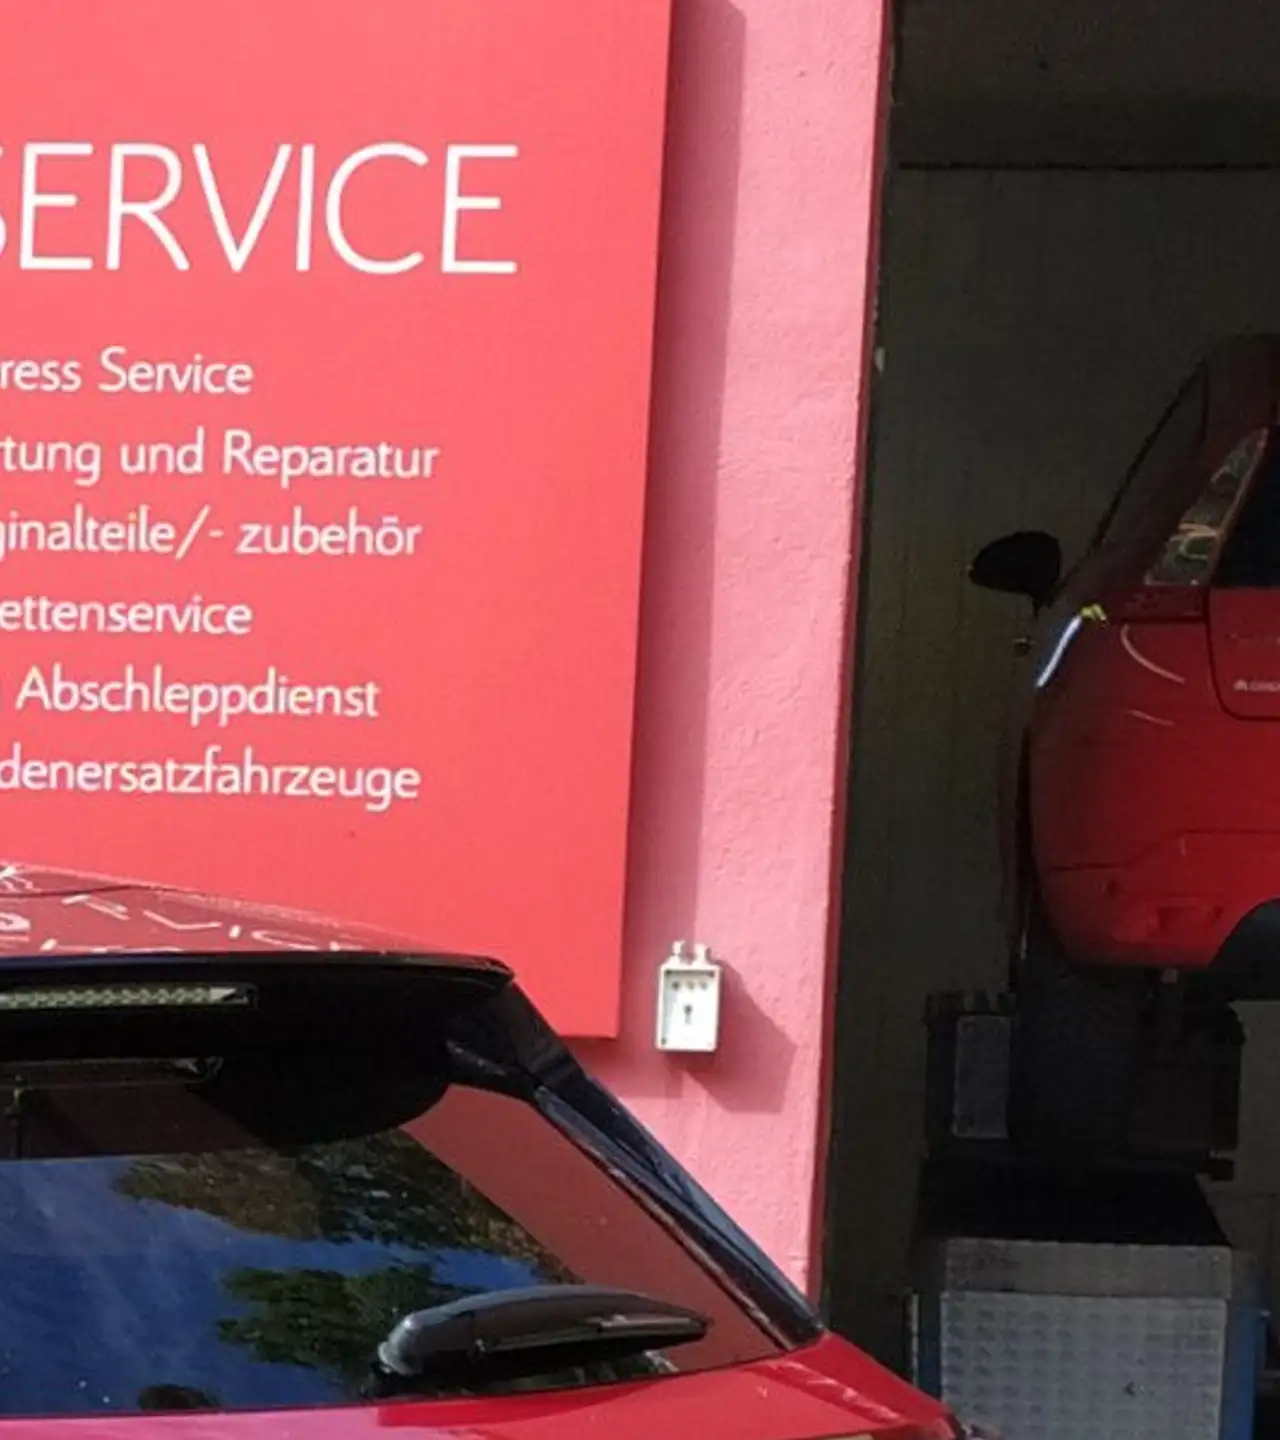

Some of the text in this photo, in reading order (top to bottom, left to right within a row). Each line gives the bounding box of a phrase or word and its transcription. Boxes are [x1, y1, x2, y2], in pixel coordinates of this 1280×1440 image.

[98, 345, 254, 394] Service
[120, 426, 205, 474] und
[223, 429, 440, 489] Reparatur
[236, 506, 423, 557] zubehör
[15, 663, 380, 726] Abschleppdienst
